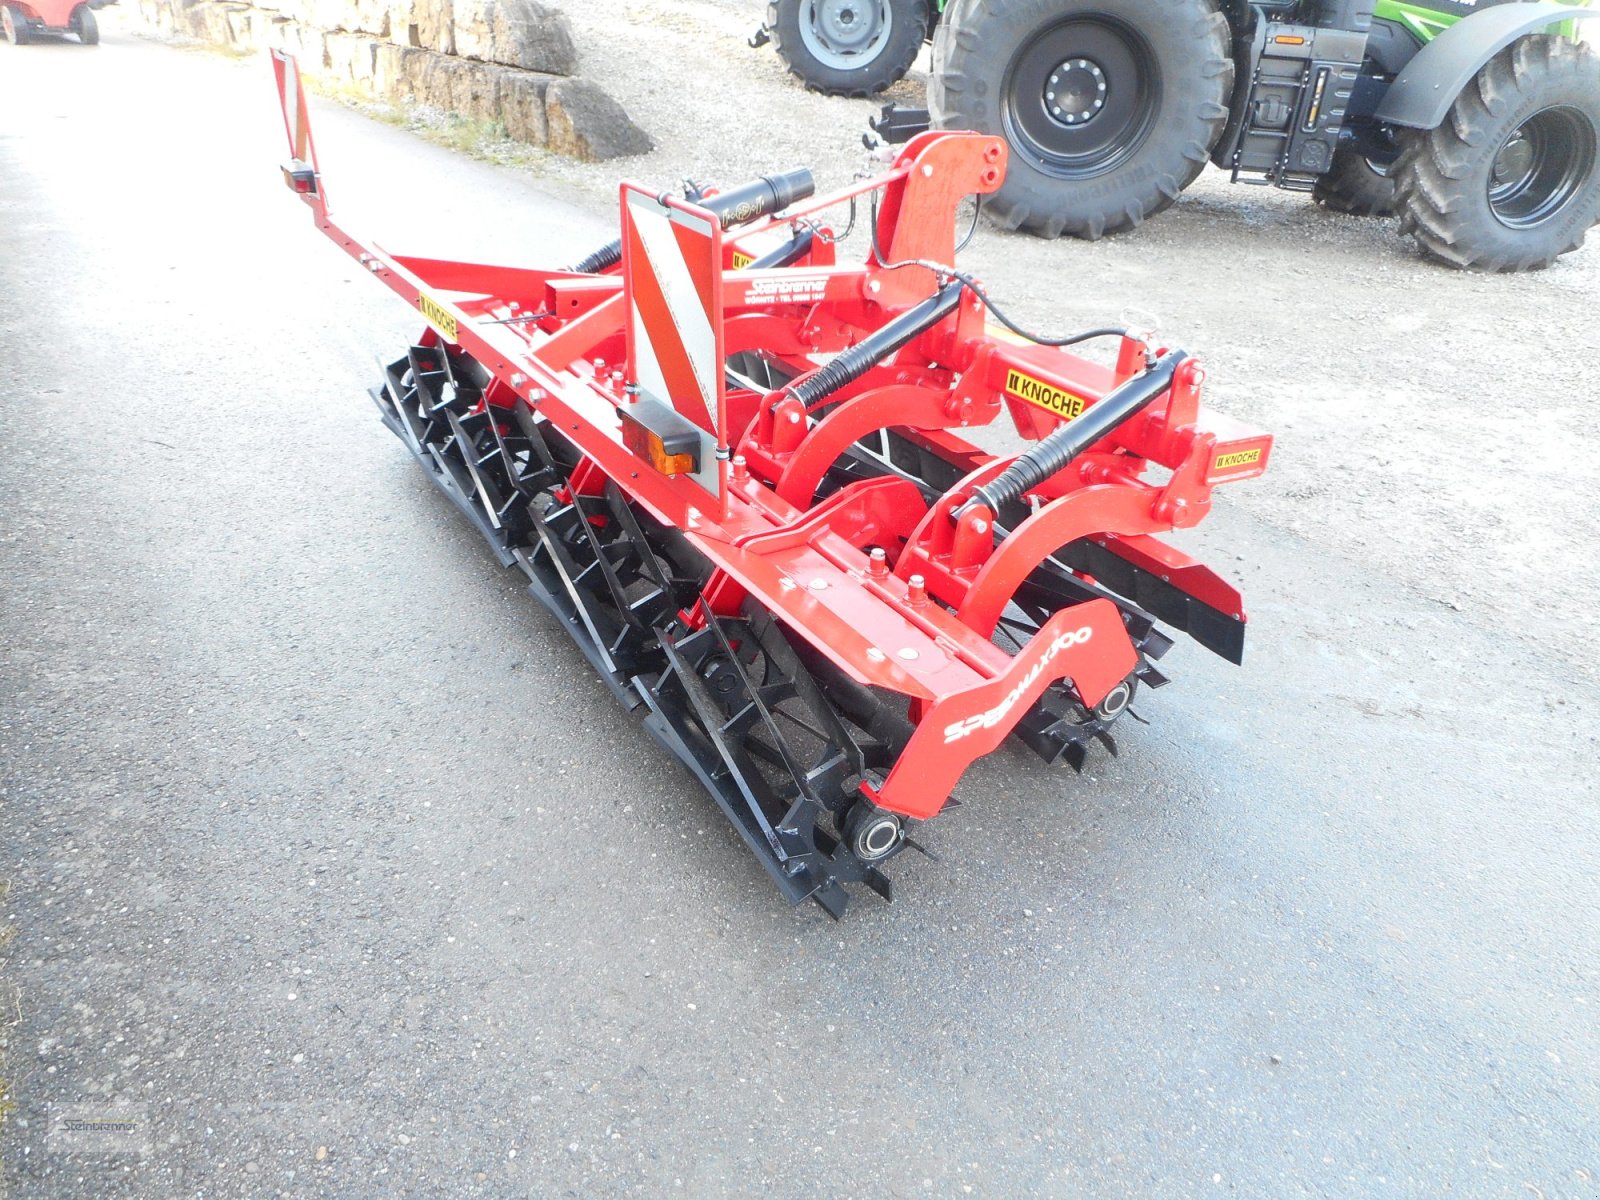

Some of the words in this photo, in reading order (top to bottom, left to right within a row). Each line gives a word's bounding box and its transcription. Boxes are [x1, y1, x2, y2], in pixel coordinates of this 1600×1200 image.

[745, 276, 829, 295] Steinbrenner
[427, 299, 456, 337] KNOCHE
[1021, 378, 1081, 418] KNOCHE
[1224, 450, 1258, 466] KNOCHE
